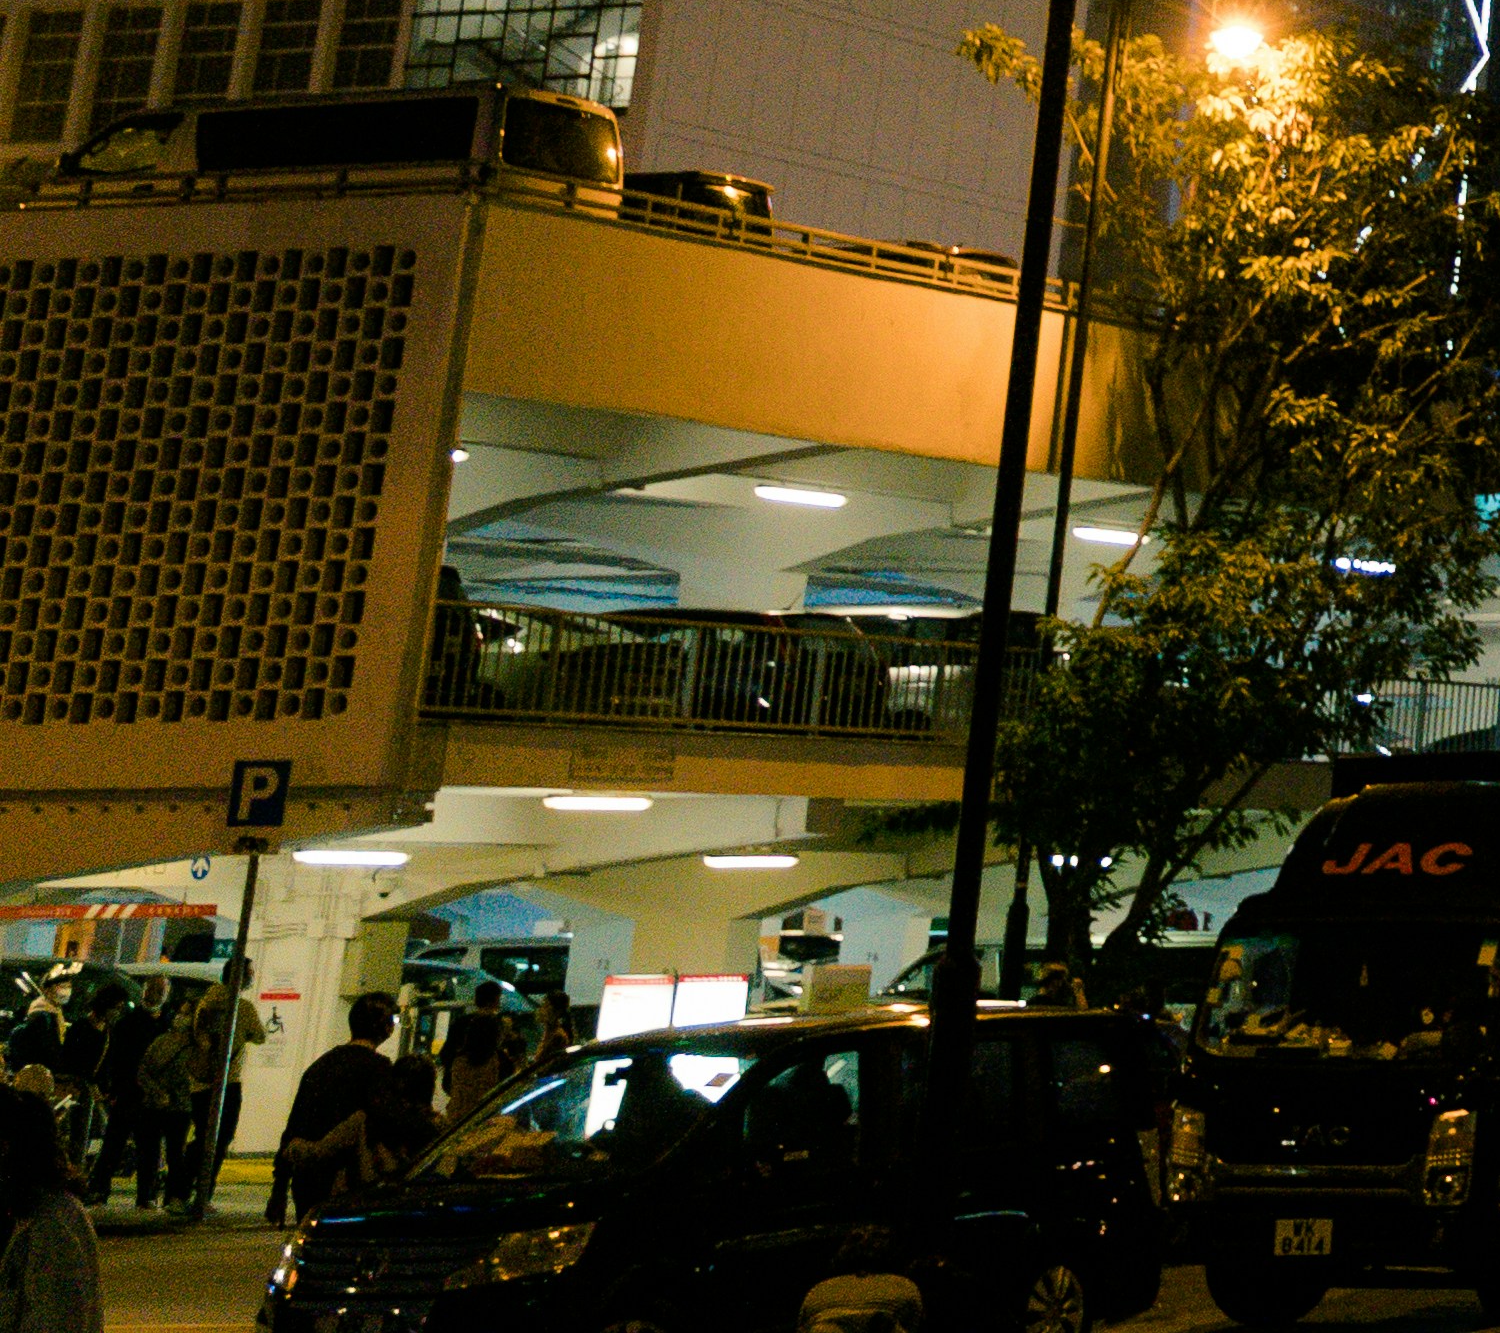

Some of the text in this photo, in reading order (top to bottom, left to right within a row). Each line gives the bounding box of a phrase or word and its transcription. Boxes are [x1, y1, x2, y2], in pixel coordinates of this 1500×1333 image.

[238, 770, 279, 821] P
[1321, 841, 1474, 876] JAC
[1282, 1236, 1325, 1254] 8414
